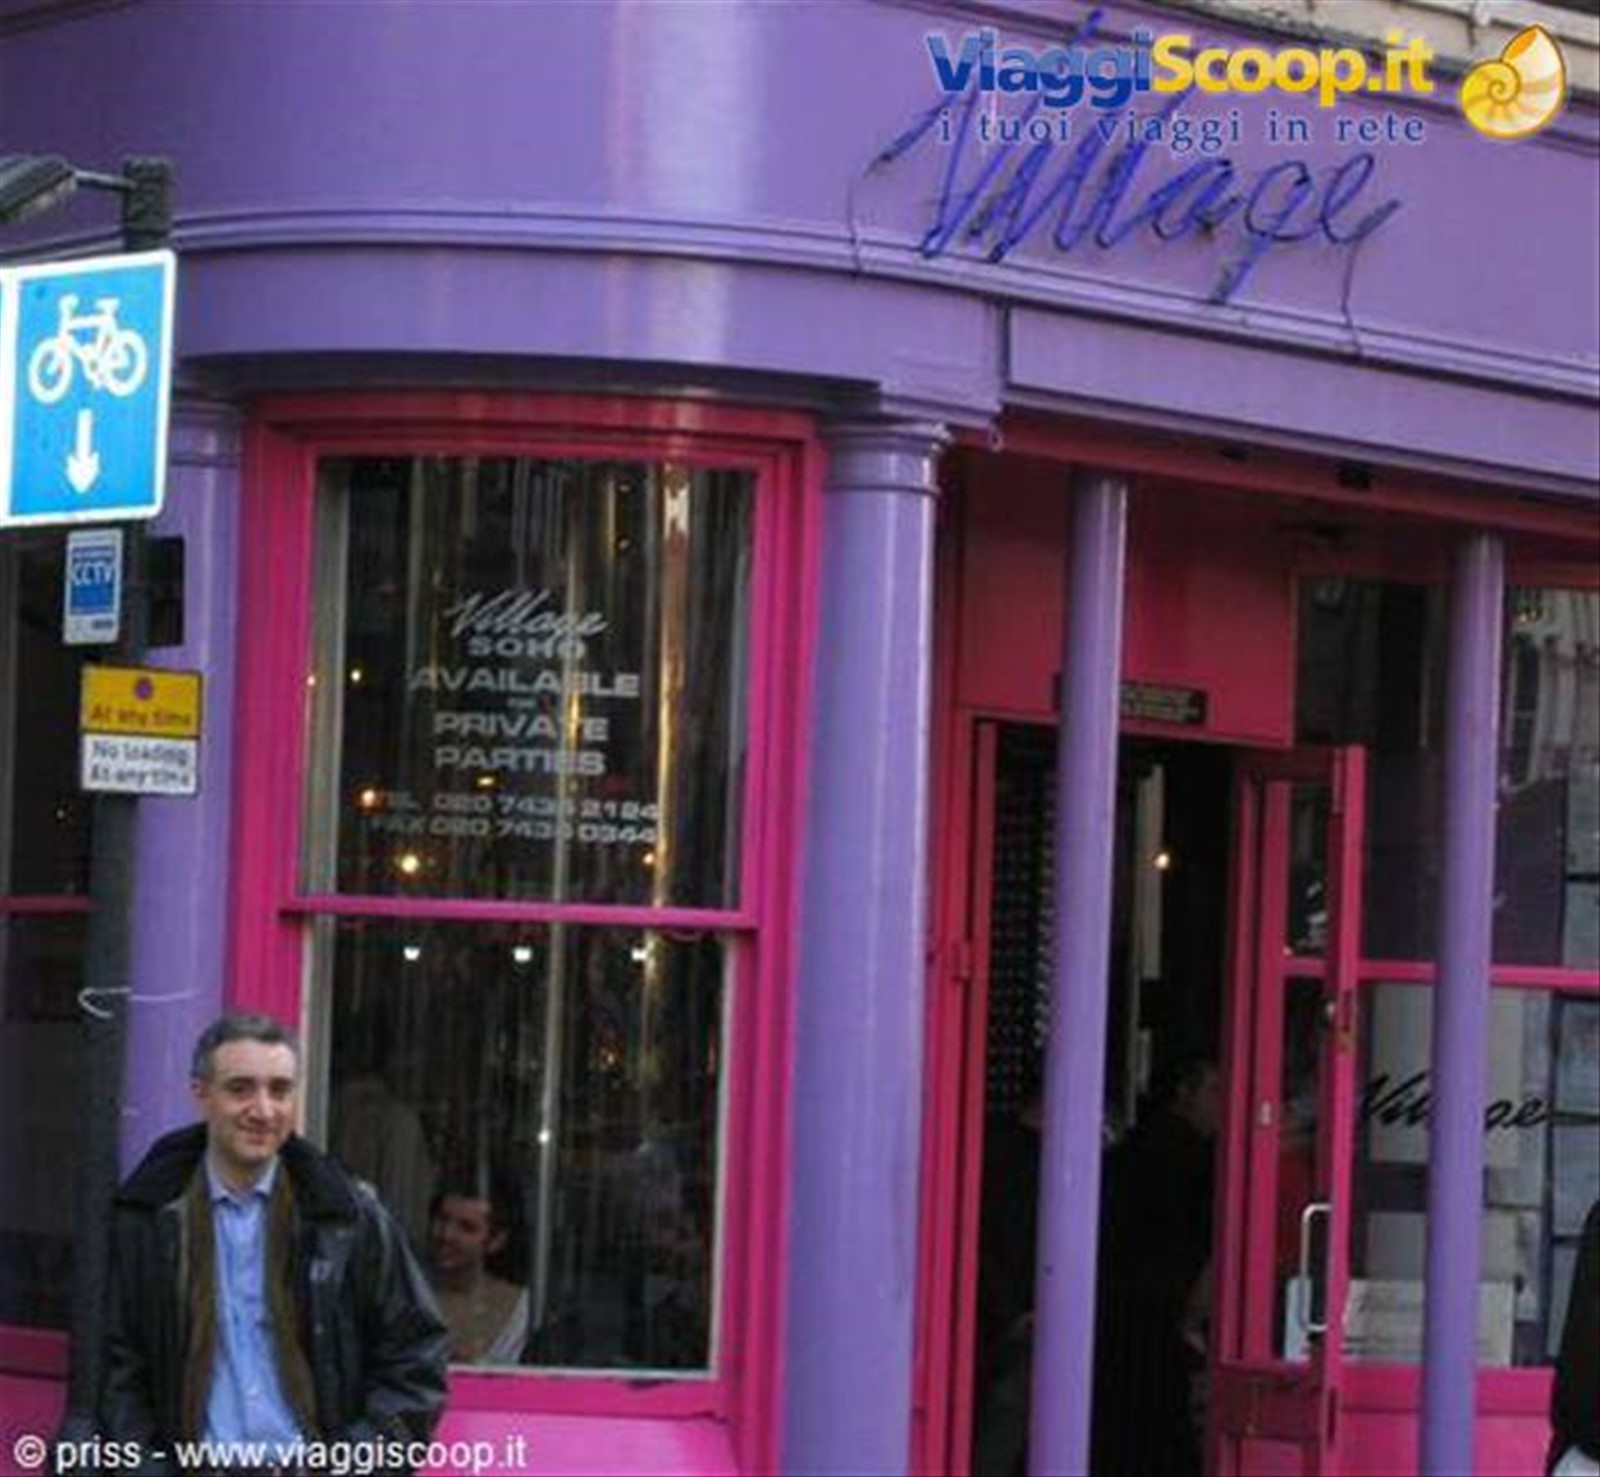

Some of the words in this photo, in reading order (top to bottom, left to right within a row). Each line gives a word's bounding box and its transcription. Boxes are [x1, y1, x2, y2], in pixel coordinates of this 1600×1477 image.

[72, 561, 113, 586] CCTV
[444, 588, 609, 640] Village
[468, 635, 587, 659] SOHO
[408, 666, 640, 697] AVAILABLE
